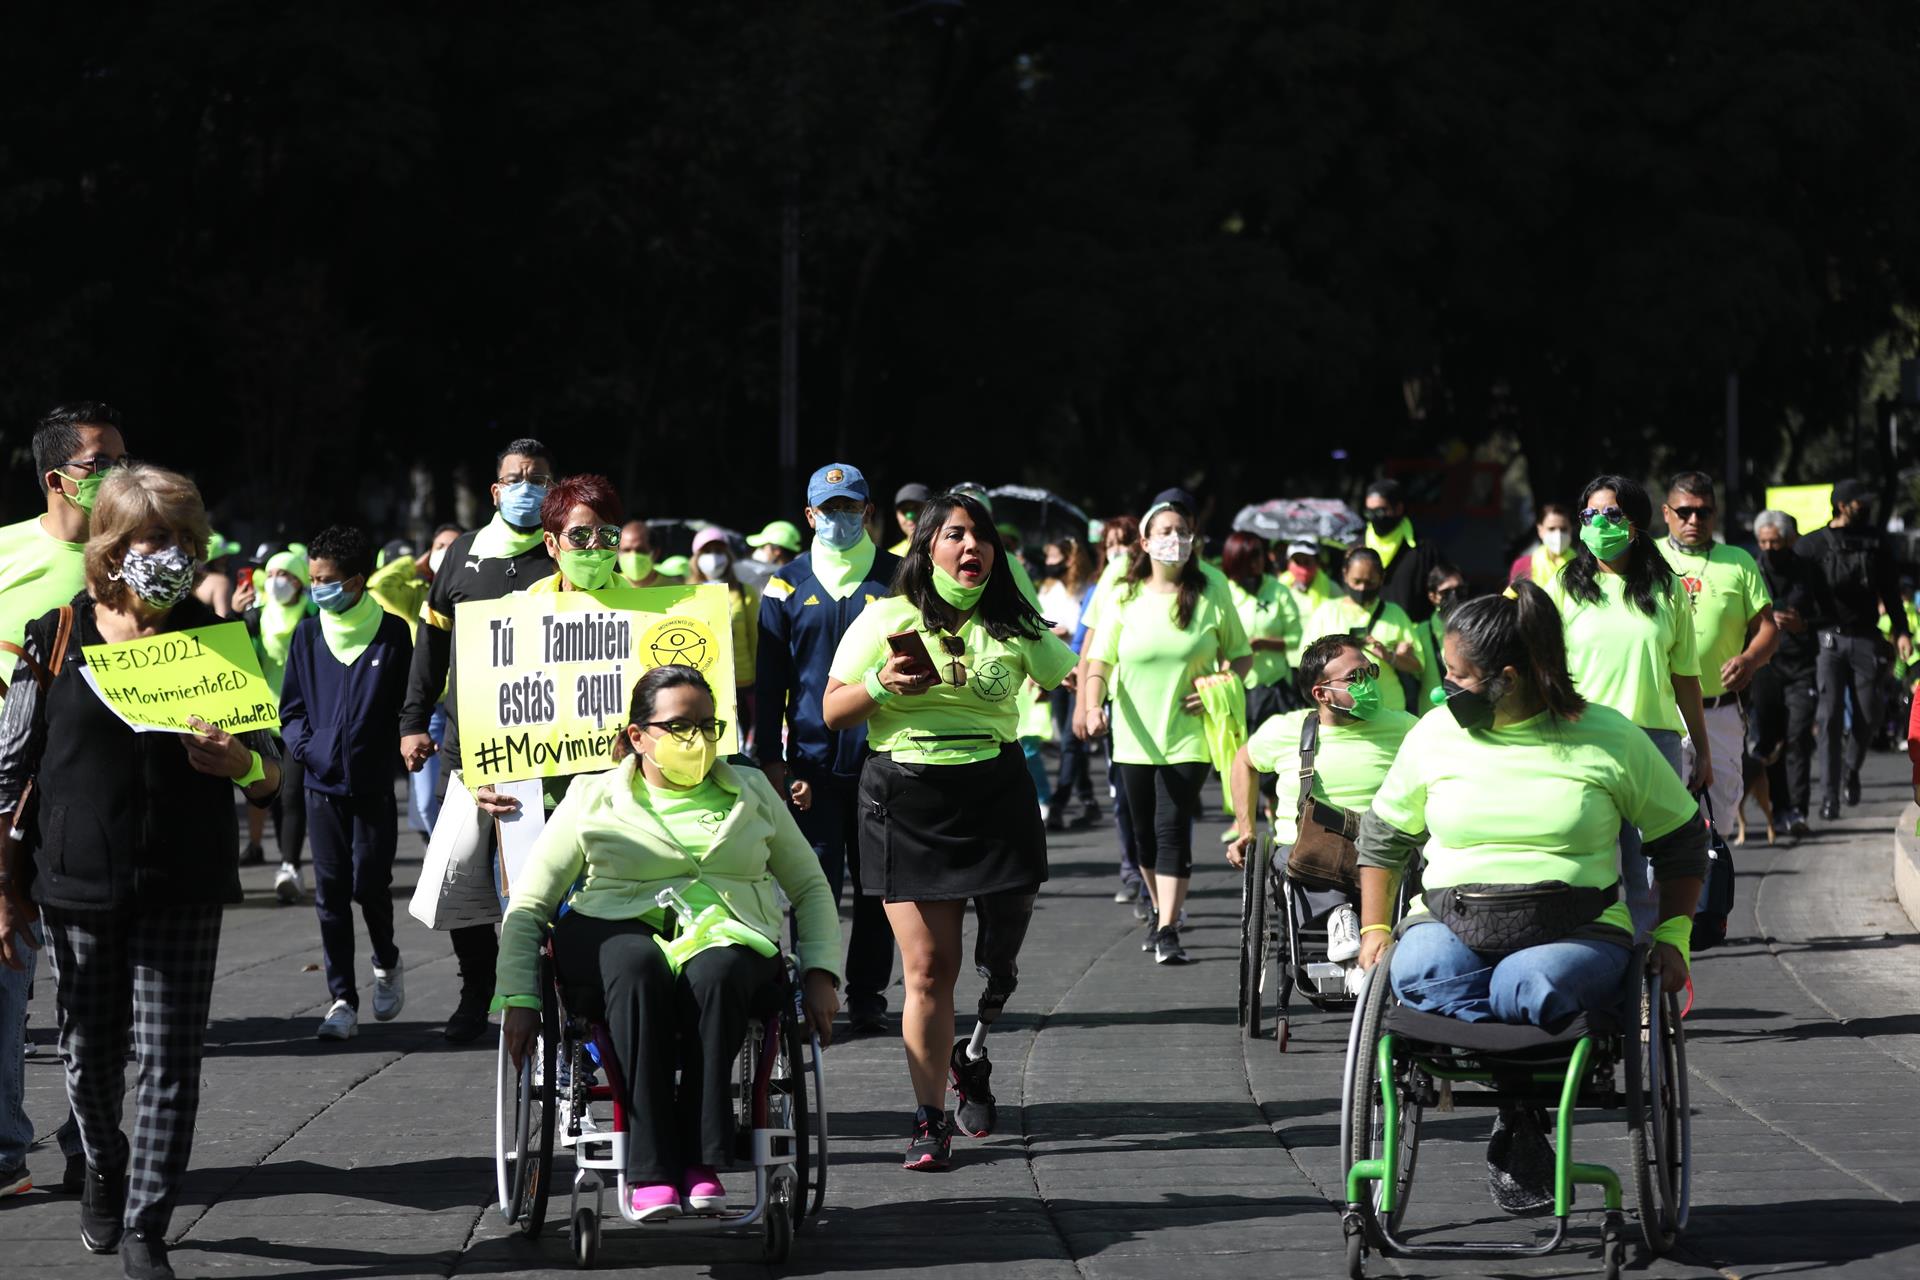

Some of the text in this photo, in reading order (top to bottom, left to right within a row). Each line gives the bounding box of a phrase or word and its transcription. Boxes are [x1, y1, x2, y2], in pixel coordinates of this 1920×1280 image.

[89, 635, 206, 673] #3D2021
[490, 612, 630, 667] Tú También
[105, 670, 248, 705] #MovimientoPcD
[499, 671, 555, 726] estás
